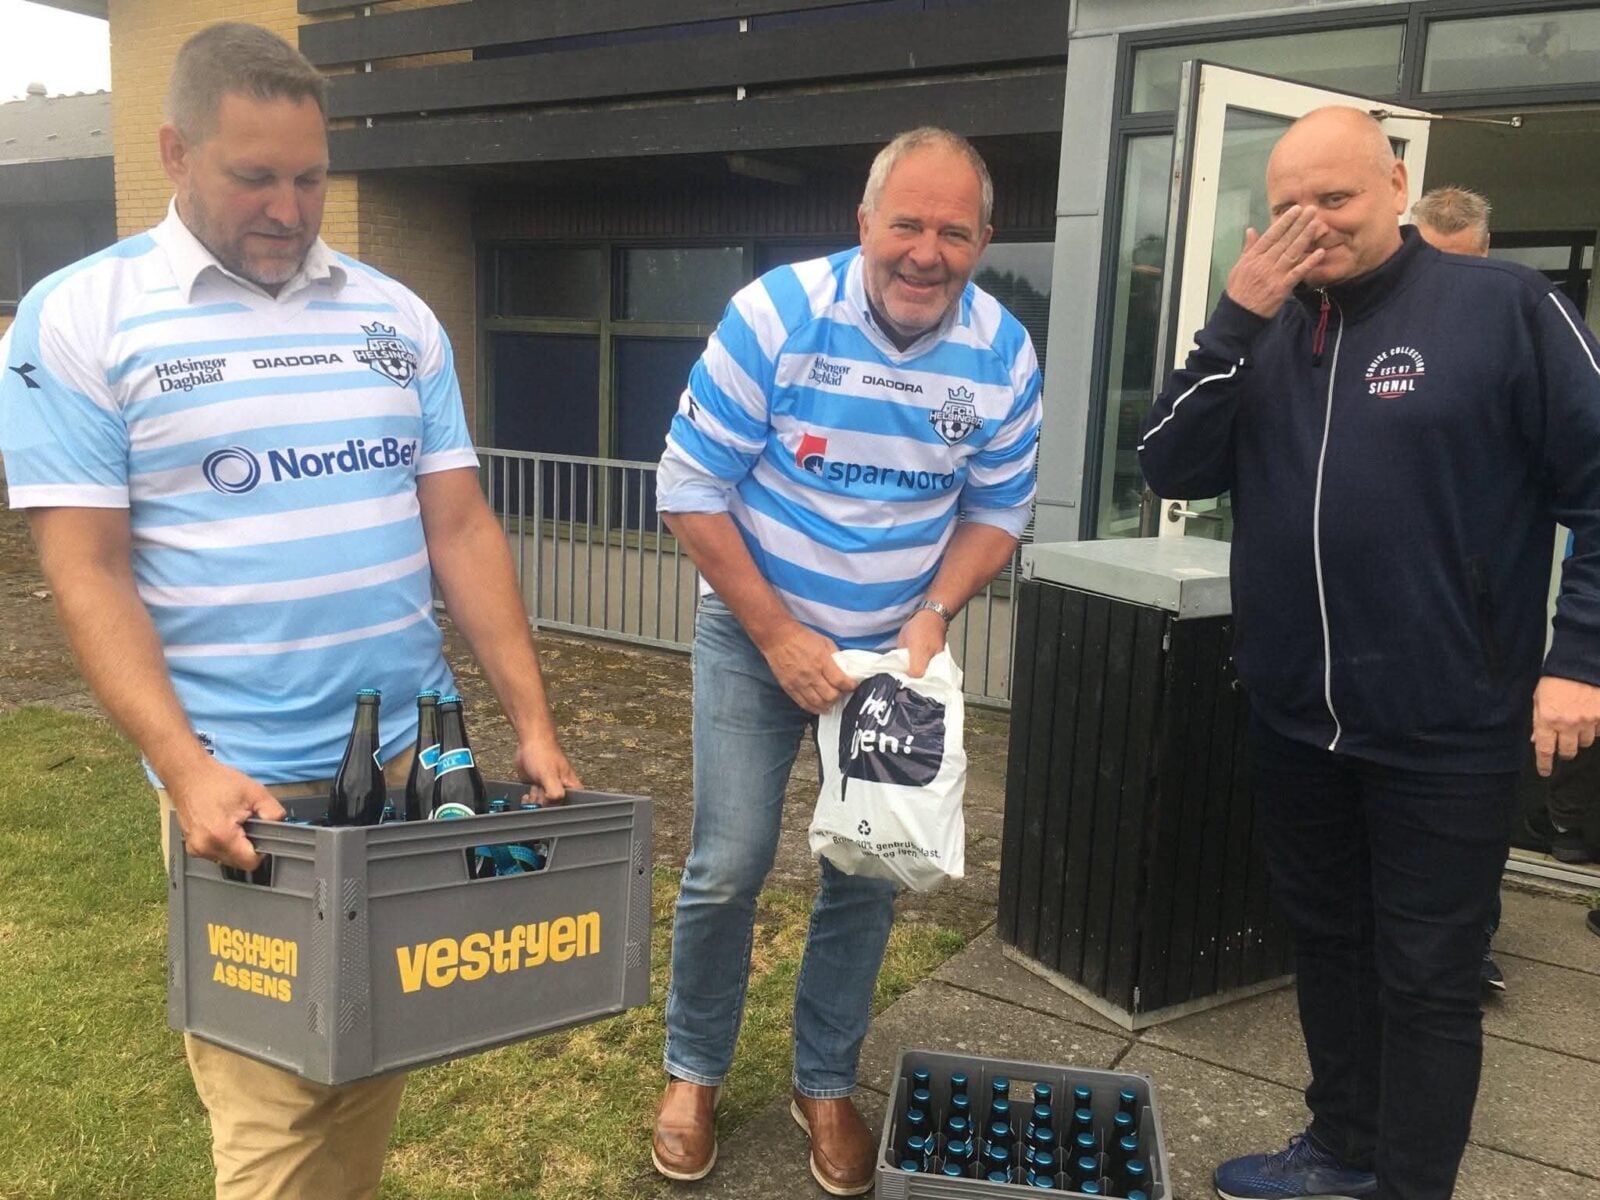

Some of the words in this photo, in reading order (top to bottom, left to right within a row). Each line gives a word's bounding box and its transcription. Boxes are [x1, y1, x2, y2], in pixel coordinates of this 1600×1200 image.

[154, 356, 227, 378] Helsingør
[253, 353, 343, 369] DIADORA
[1365, 352, 1389, 378] CRUISE
[1390, 346, 1425, 373] COLLECTION
[159, 368, 224, 393] Dagblad
[862, 375, 924, 394] DIADORA
[1368, 379, 1415, 395] SIGNAL
[267, 437, 417, 482] NordicBet
[212, 960, 292, 1003] ASSENS
